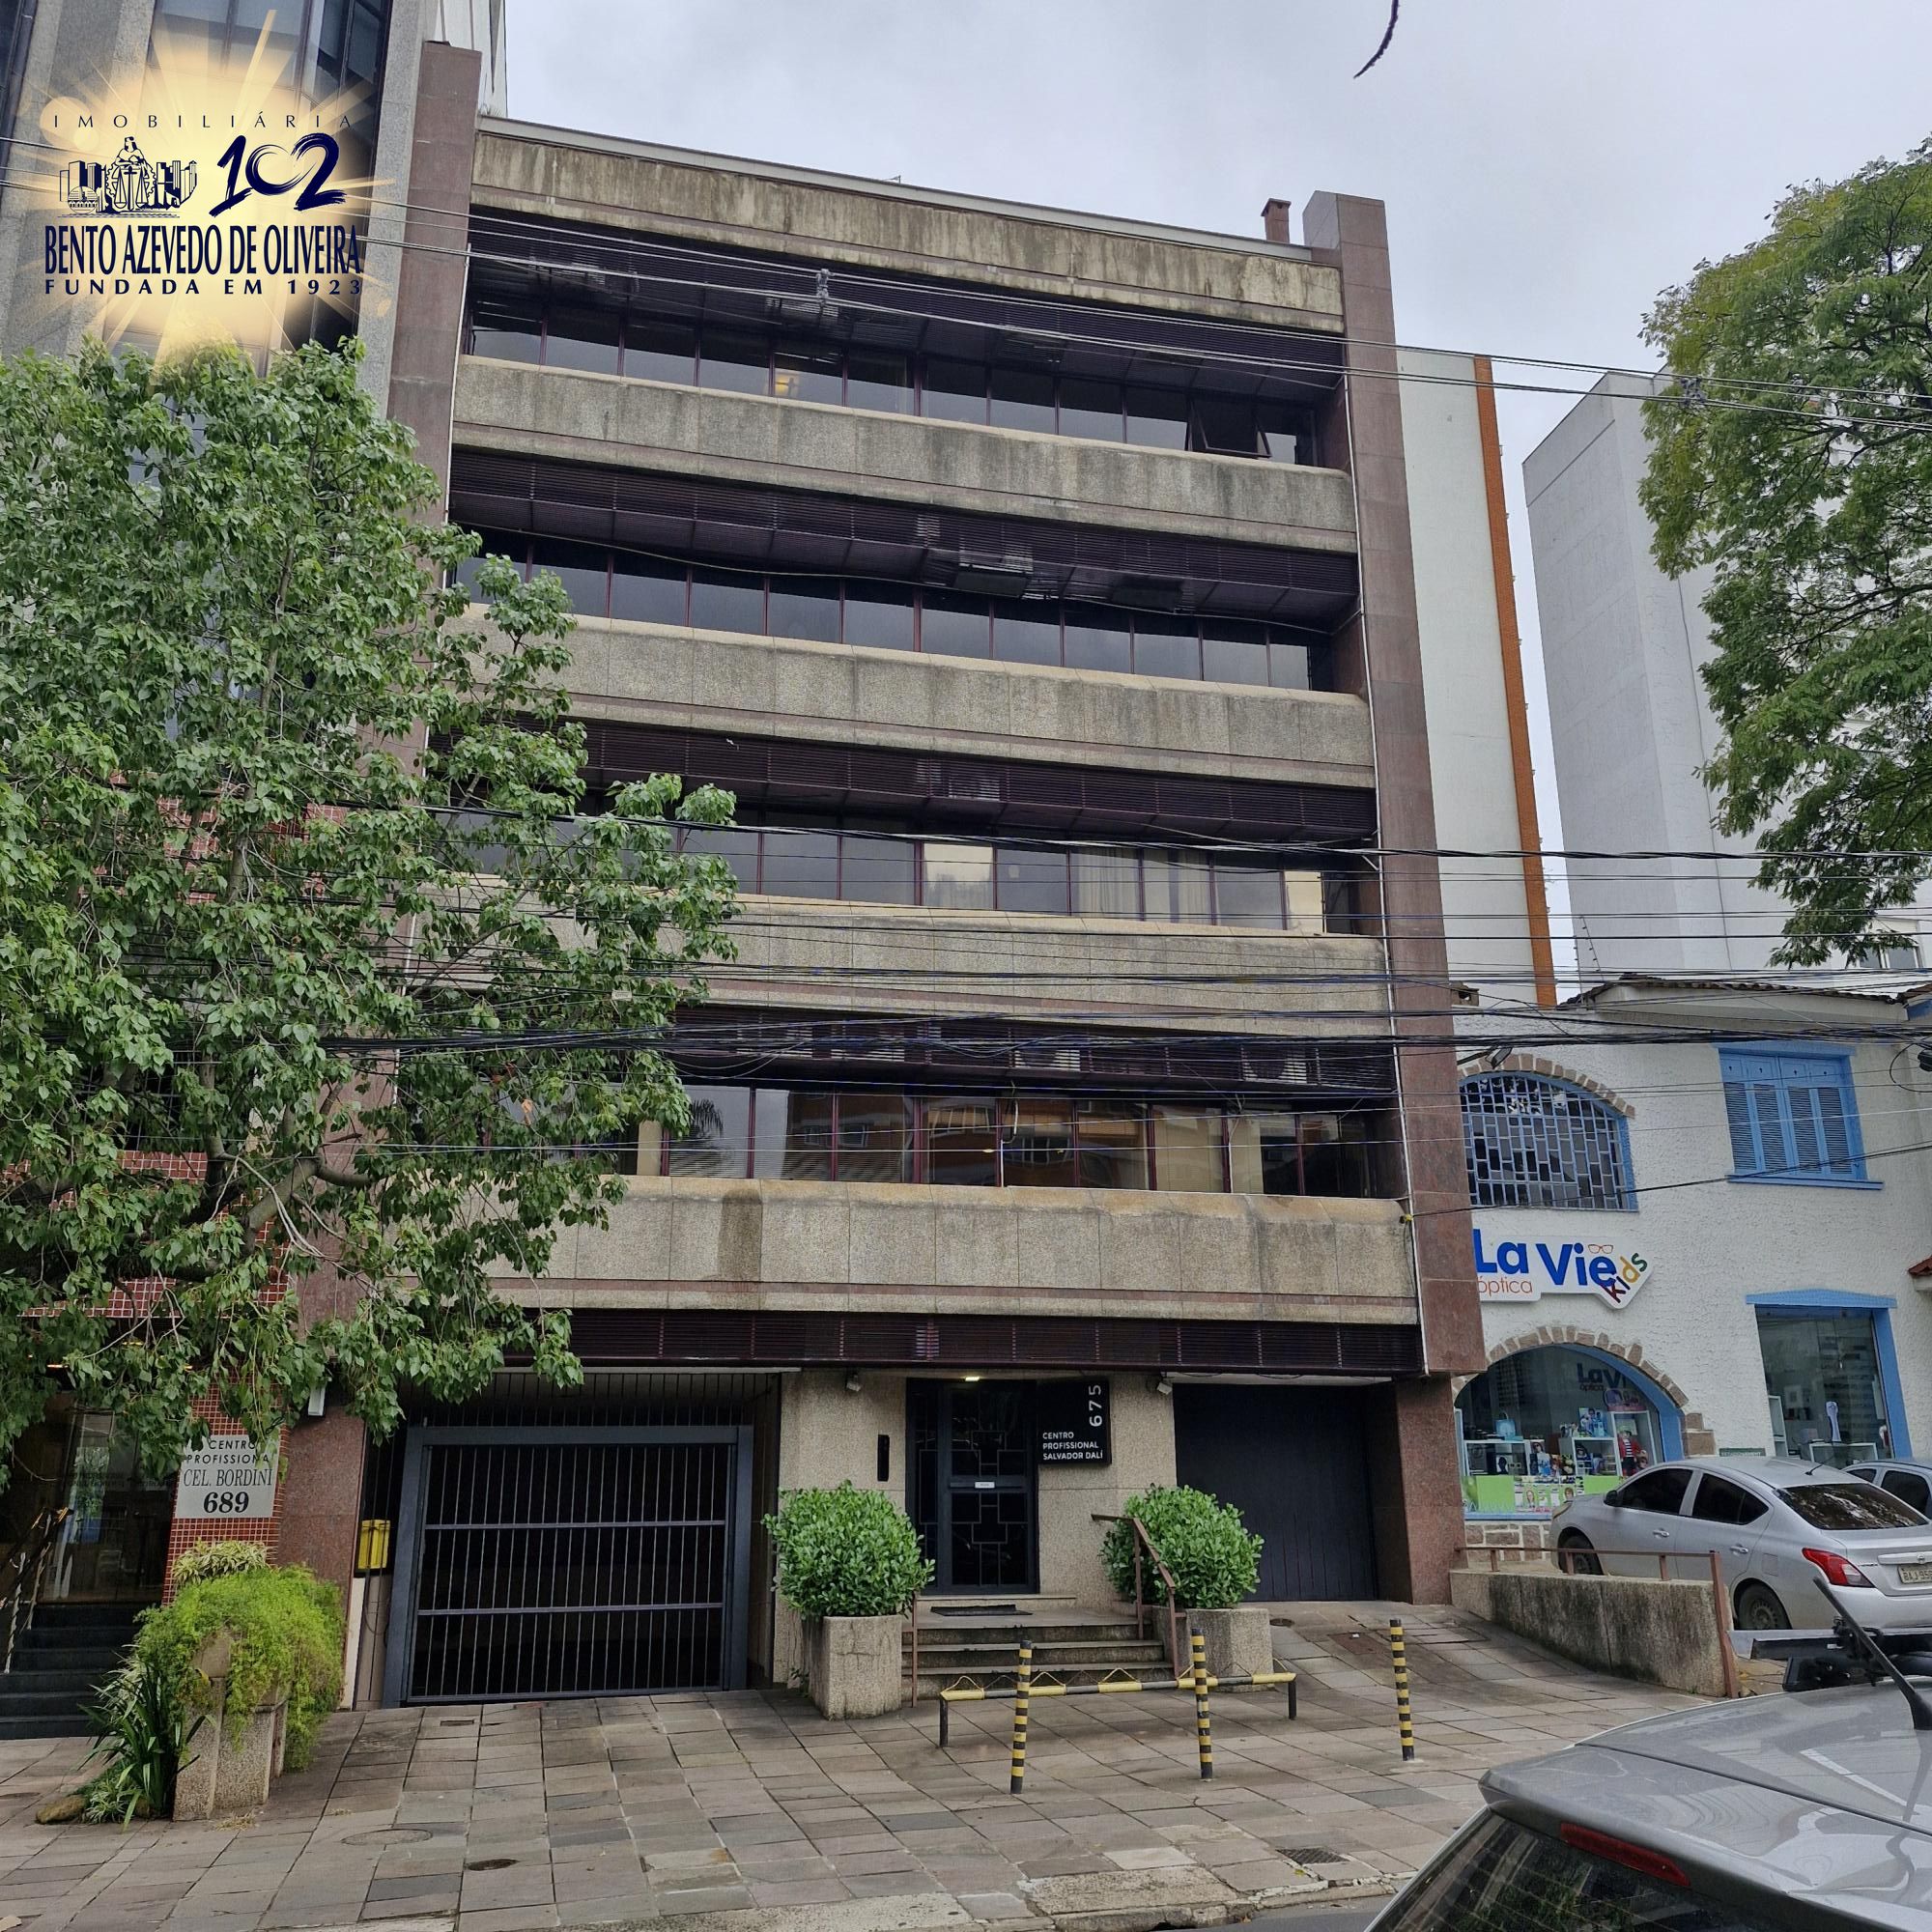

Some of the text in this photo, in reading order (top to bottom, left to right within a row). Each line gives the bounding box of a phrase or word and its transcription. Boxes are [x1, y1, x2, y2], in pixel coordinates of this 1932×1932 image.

[1473, 1229, 1617, 1287] La Vie
[1477, 1276, 1533, 1296] óptica
[1088, 1384, 1102, 1427] 675
[209, 1439, 255, 1449] CENTRO
[1042, 1441, 1098, 1450] PROFISSIONAL
[184, 1468, 272, 1486] CEL. BORDINI
[203, 1492, 249, 1514] 689
